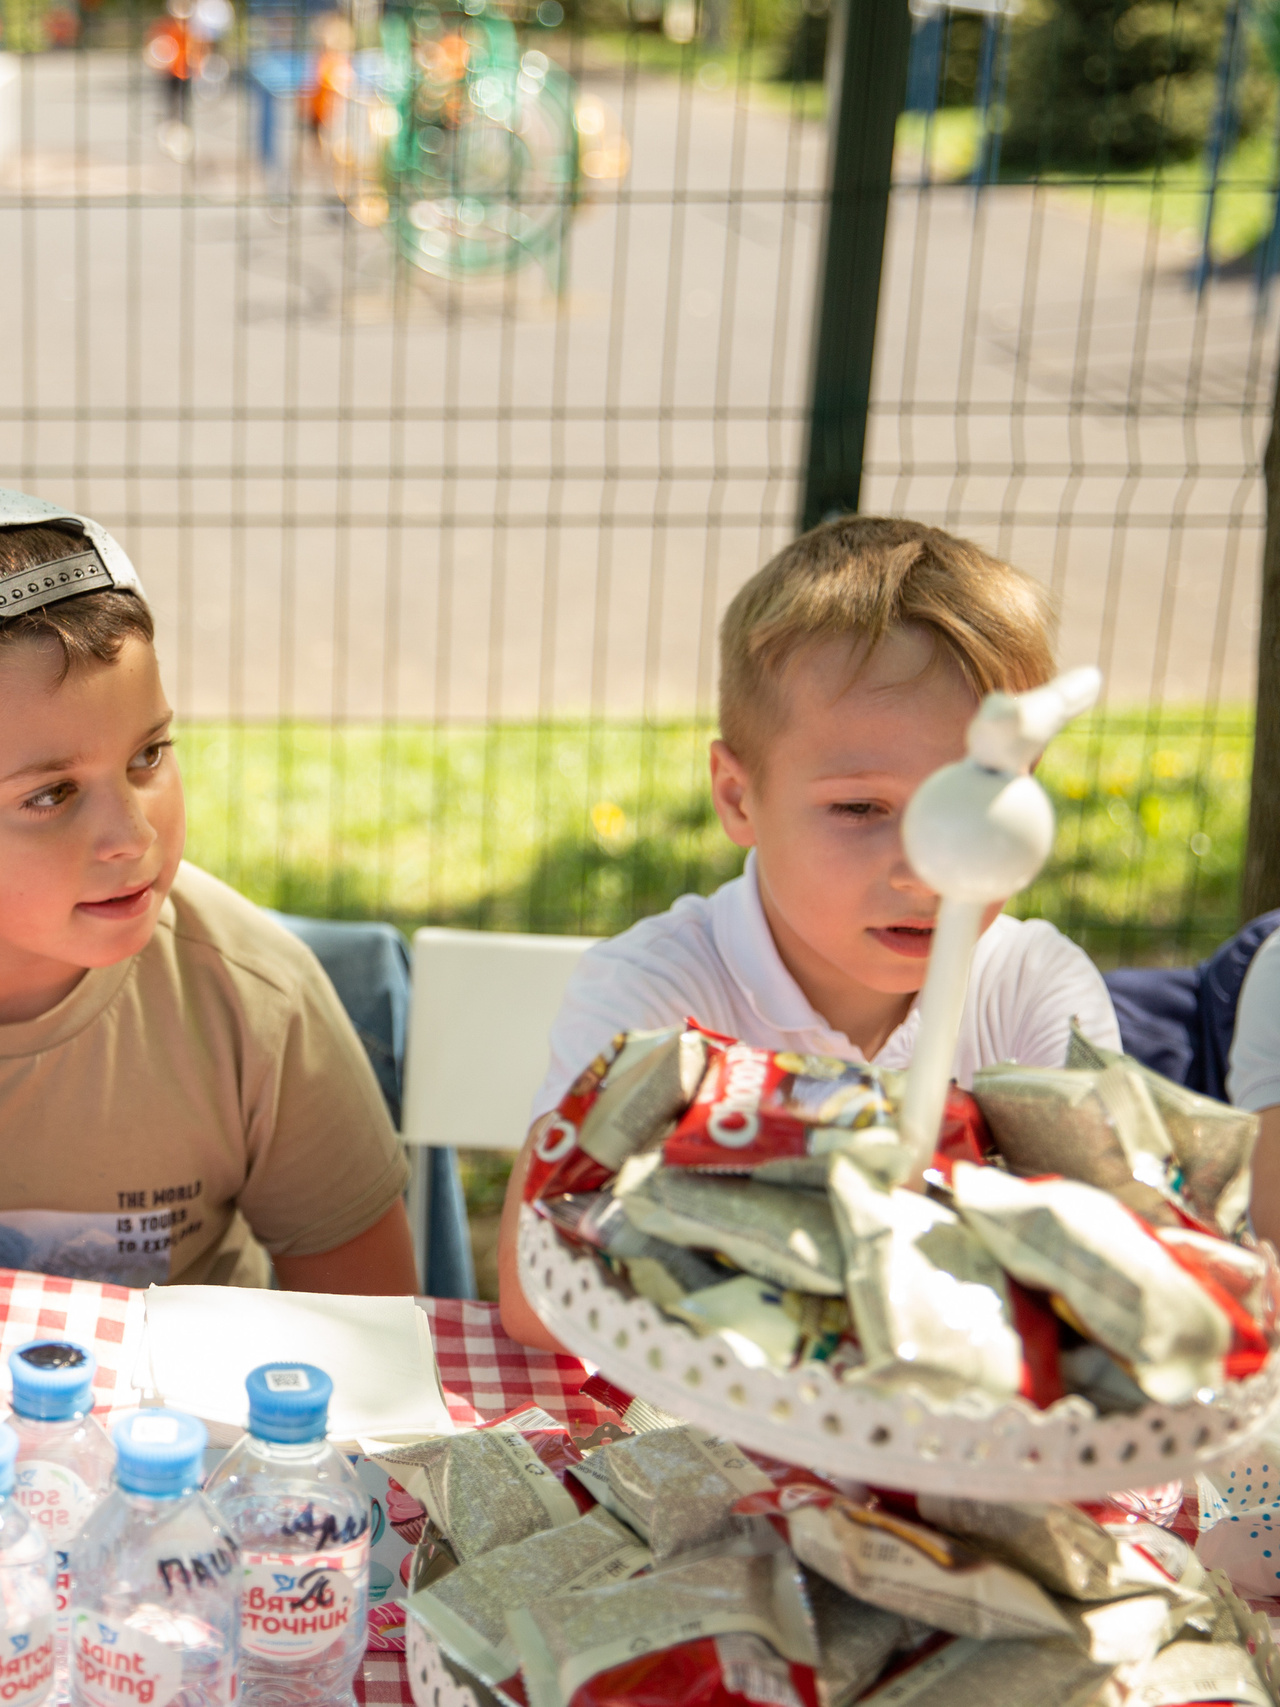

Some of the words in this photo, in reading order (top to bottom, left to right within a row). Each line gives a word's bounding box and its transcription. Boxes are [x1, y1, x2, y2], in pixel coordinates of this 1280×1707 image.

[117, 1190, 145, 1210] THE
[152, 1179, 202, 1207] WORLD
[117, 1217, 133, 1234] IS
[139, 1208, 187, 1234] YOURS
[117, 1240, 137, 1254] TO
[81, 1636, 145, 1675] saint
